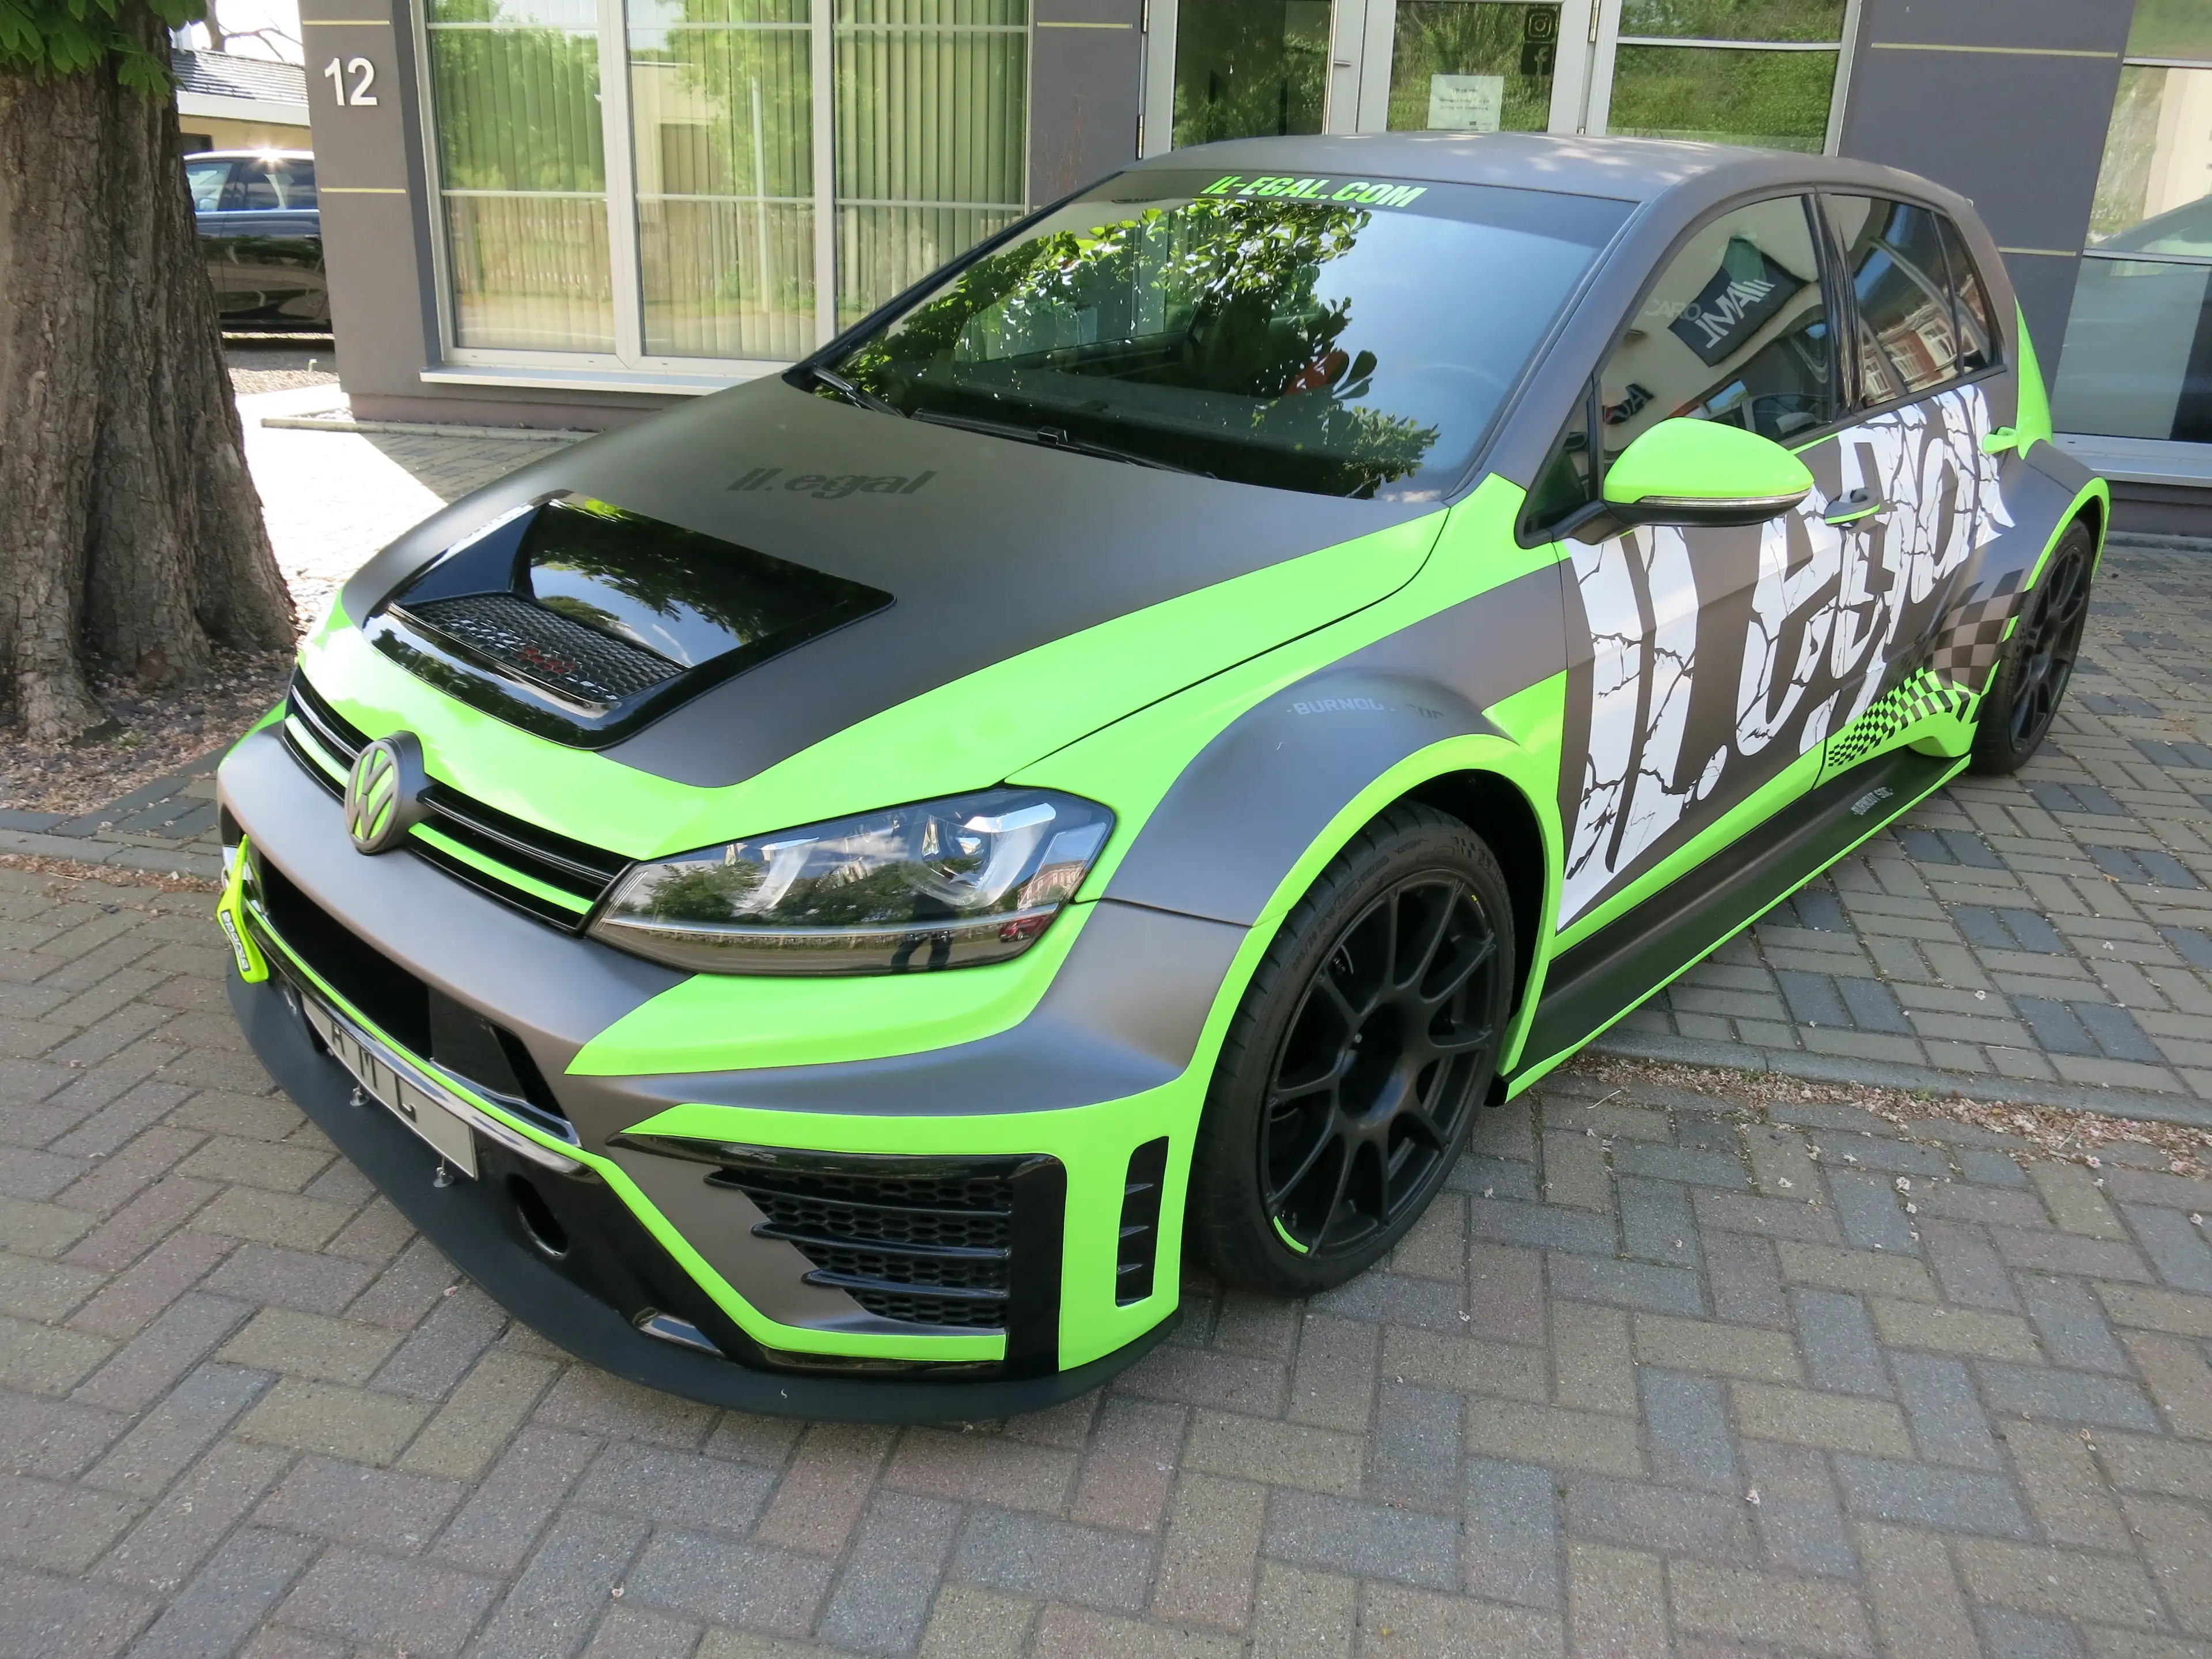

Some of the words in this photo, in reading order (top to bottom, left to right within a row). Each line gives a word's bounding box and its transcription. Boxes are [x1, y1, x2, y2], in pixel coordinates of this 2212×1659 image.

[324, 56, 378, 107] 12
[1200, 175, 1428, 208] IL-EGAL.COM
[1293, 698, 1396, 715] BURNOU
